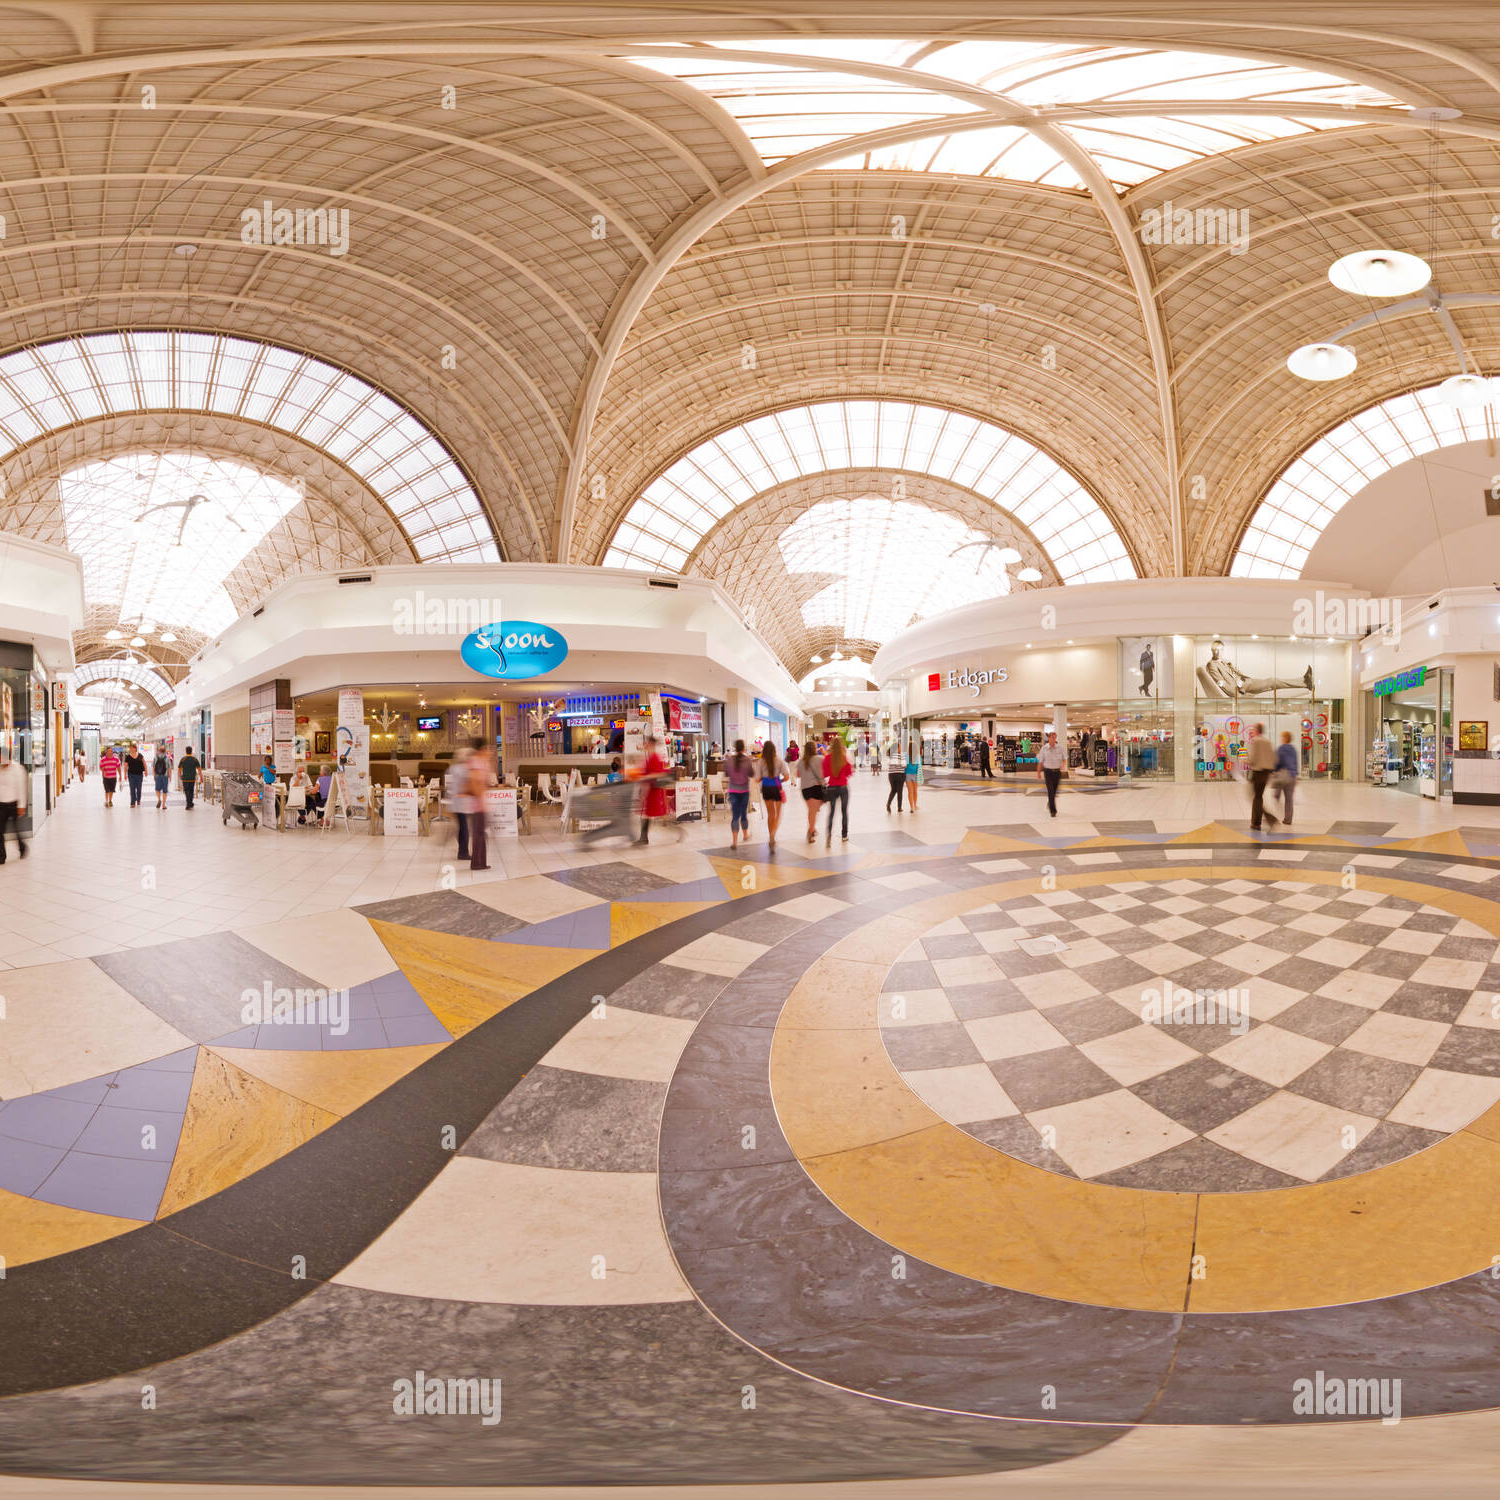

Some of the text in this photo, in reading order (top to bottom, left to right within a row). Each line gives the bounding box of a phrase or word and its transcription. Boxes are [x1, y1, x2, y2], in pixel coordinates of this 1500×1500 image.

[947, 667, 1008, 698] Edgars
[1373, 666, 1427, 699] FOTO FIRST
[569, 717, 601, 727] pizzeria
